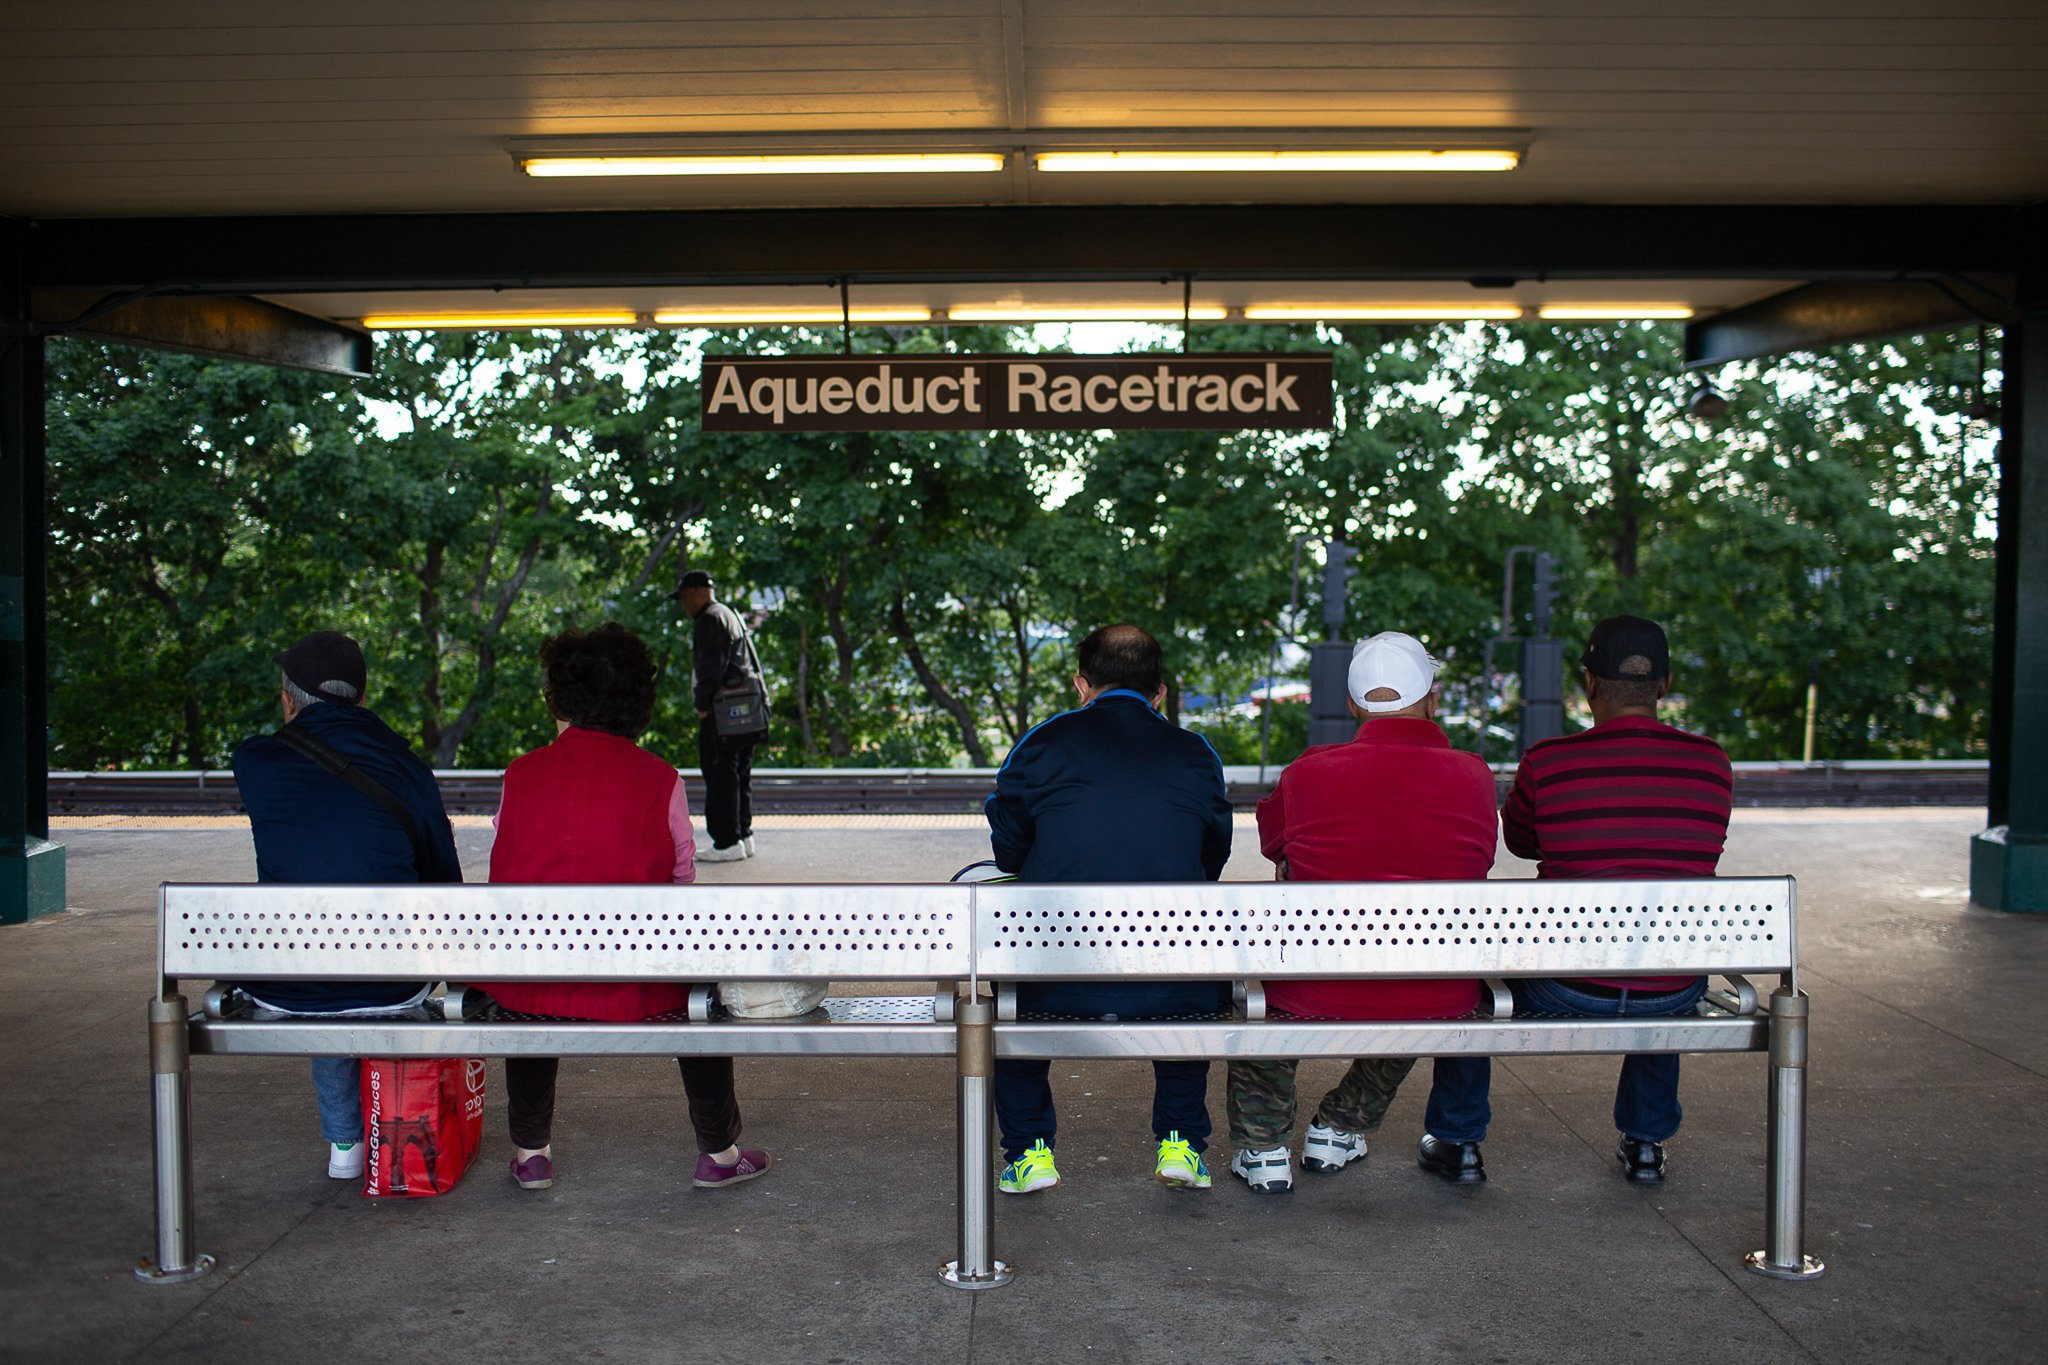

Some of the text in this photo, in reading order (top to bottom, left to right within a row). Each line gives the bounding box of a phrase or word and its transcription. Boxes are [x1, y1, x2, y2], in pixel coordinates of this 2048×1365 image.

[707, 363, 1300, 424] Aqueduct Racetrack
[368, 1070, 381, 1195] #LetsGoPlaces
